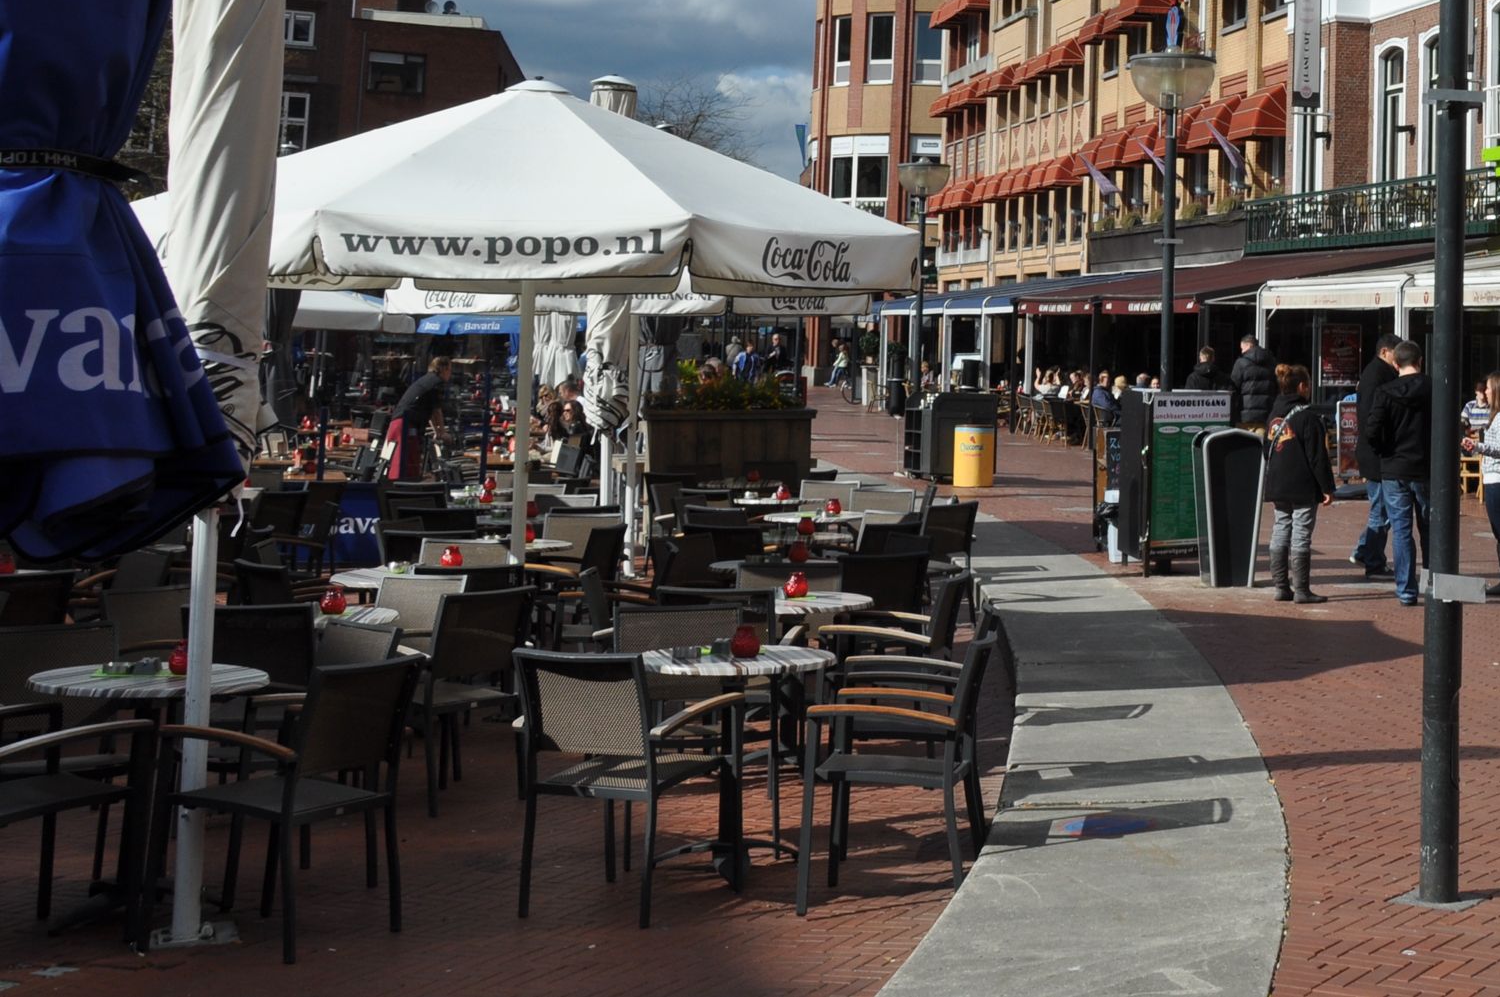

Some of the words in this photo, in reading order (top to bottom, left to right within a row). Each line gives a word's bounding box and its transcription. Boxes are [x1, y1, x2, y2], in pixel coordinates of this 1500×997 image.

[0, 152, 78, 168] WWW.TOP
[340, 228, 665, 265] www.popo.nl
[762, 236, 851, 283] Coca-Cola
